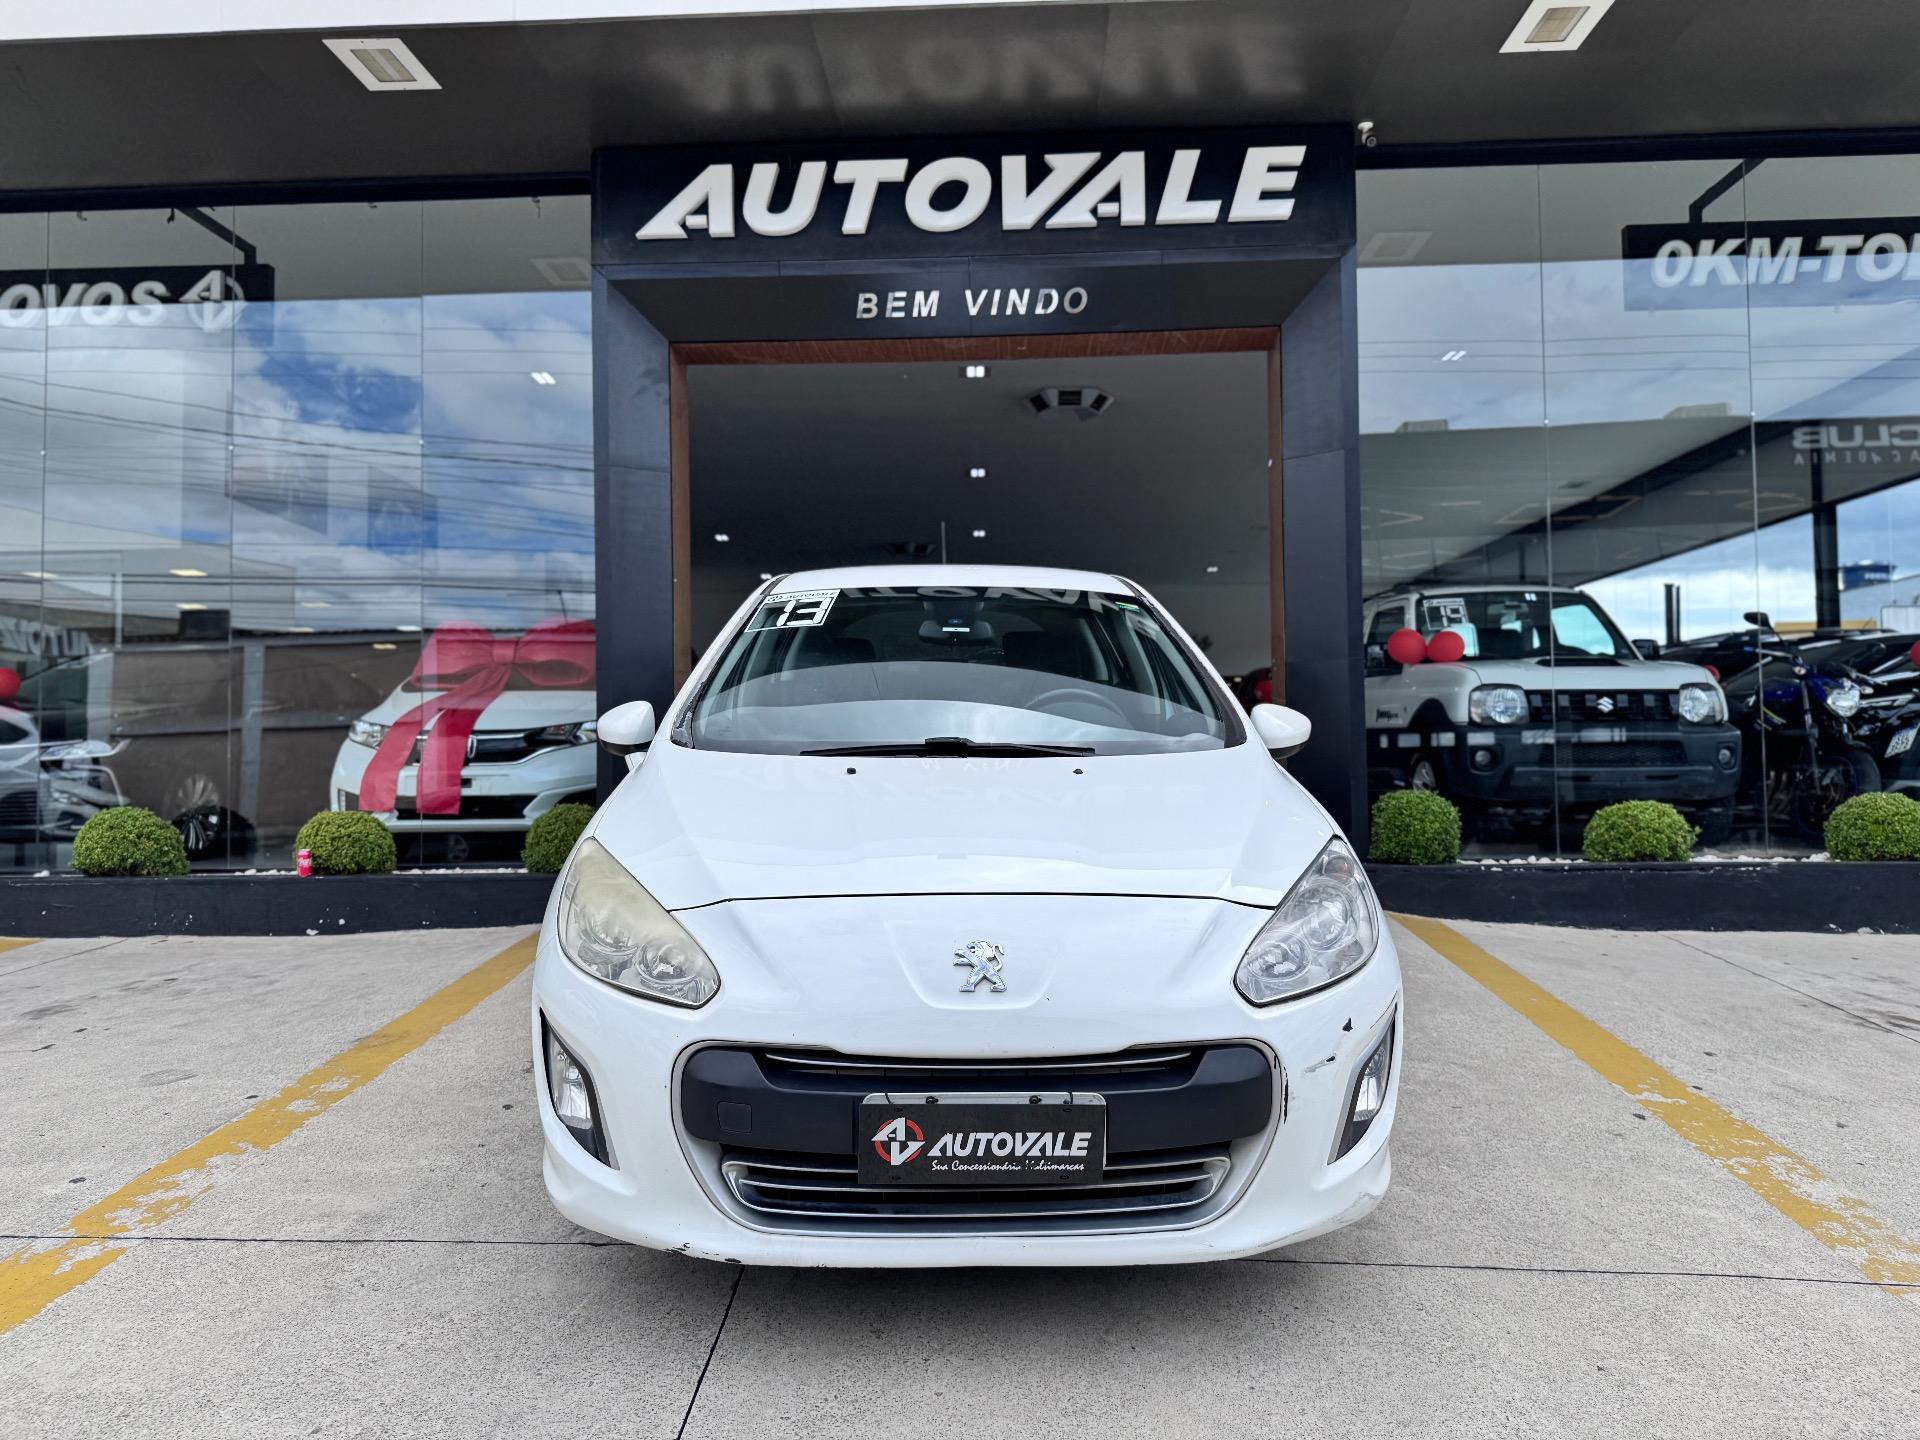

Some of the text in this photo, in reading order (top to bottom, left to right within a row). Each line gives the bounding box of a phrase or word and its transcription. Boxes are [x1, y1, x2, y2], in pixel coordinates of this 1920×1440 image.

[635, 145, 1307, 240] AUTOVALE
[1651, 232, 1920, 288] 0KM-TO
[0, 280, 171, 327] OVOS
[856, 287, 1088, 319] BEM VINDO
[776, 597, 832, 627] 13
[927, 1132, 1092, 1157] AUTOVALE
[931, 1160, 949, 1171] Sua
